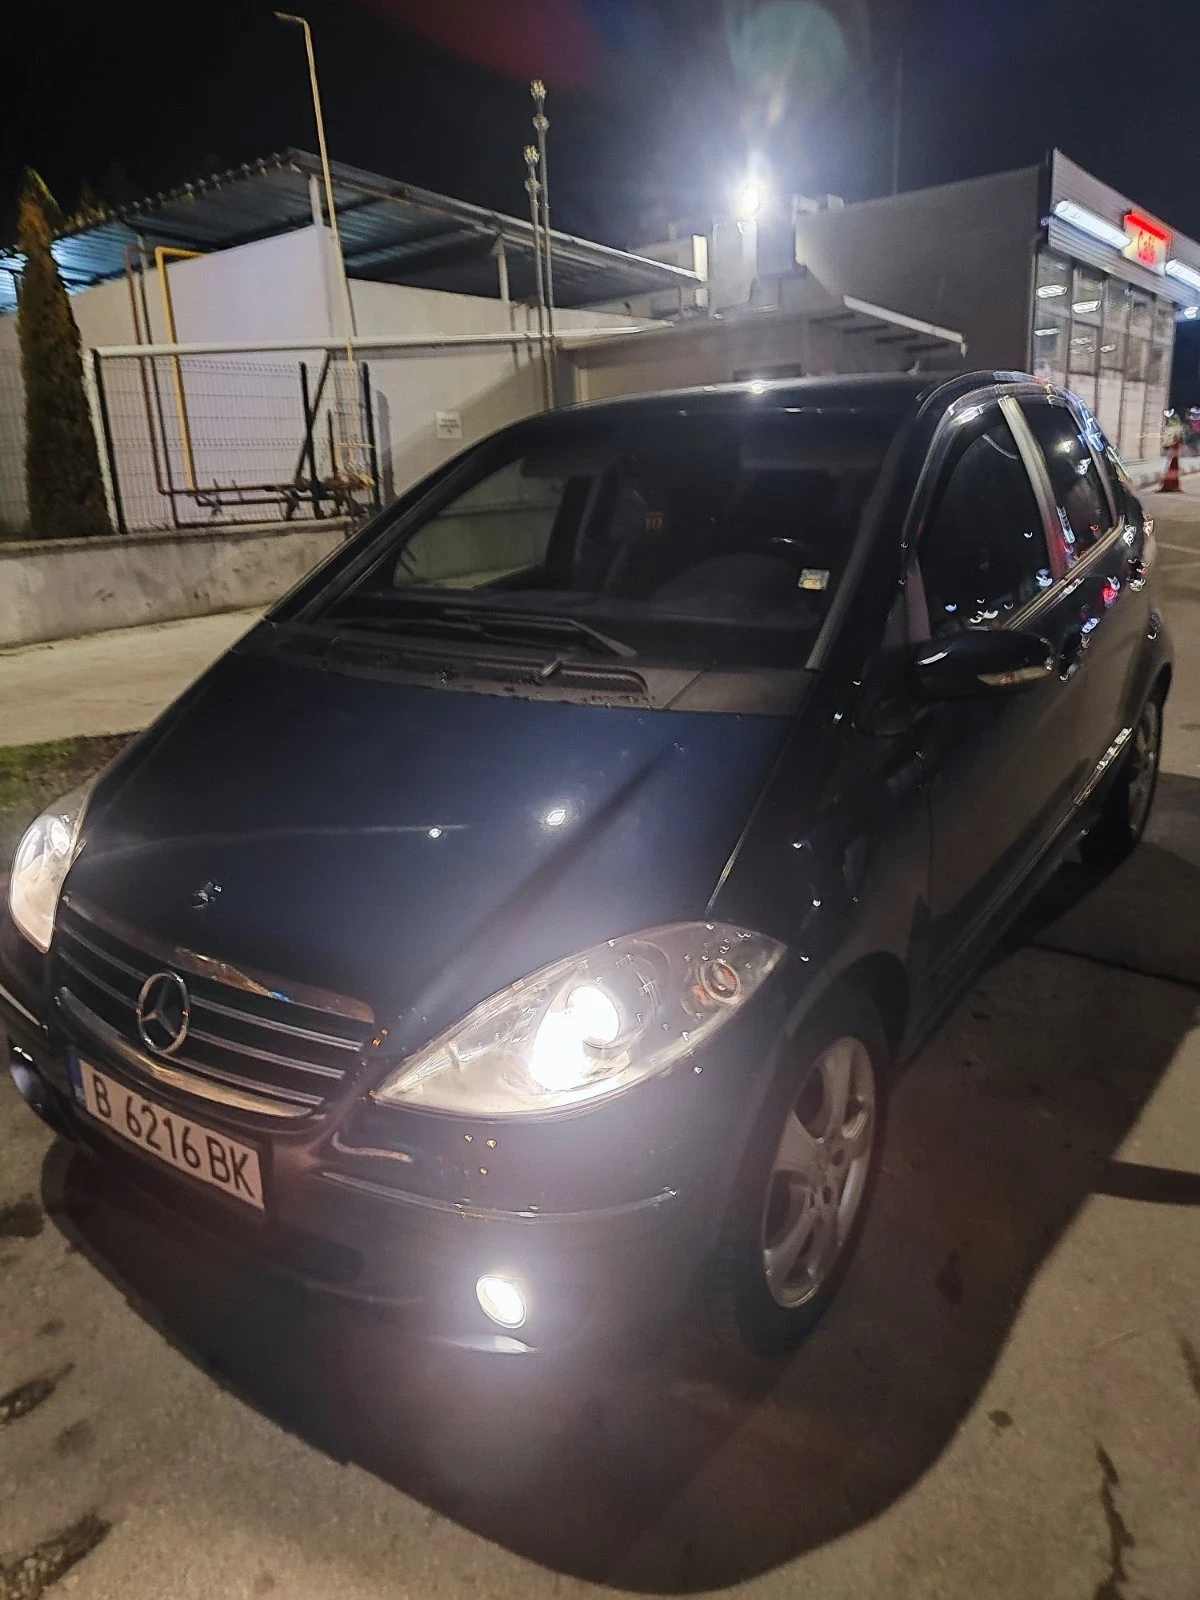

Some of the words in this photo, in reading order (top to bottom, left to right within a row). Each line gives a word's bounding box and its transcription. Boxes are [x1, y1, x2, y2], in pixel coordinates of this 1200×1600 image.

[92, 1073, 112, 1118] B
[124, 1096, 201, 1169] 6216
[206, 1135, 256, 1198] BK
